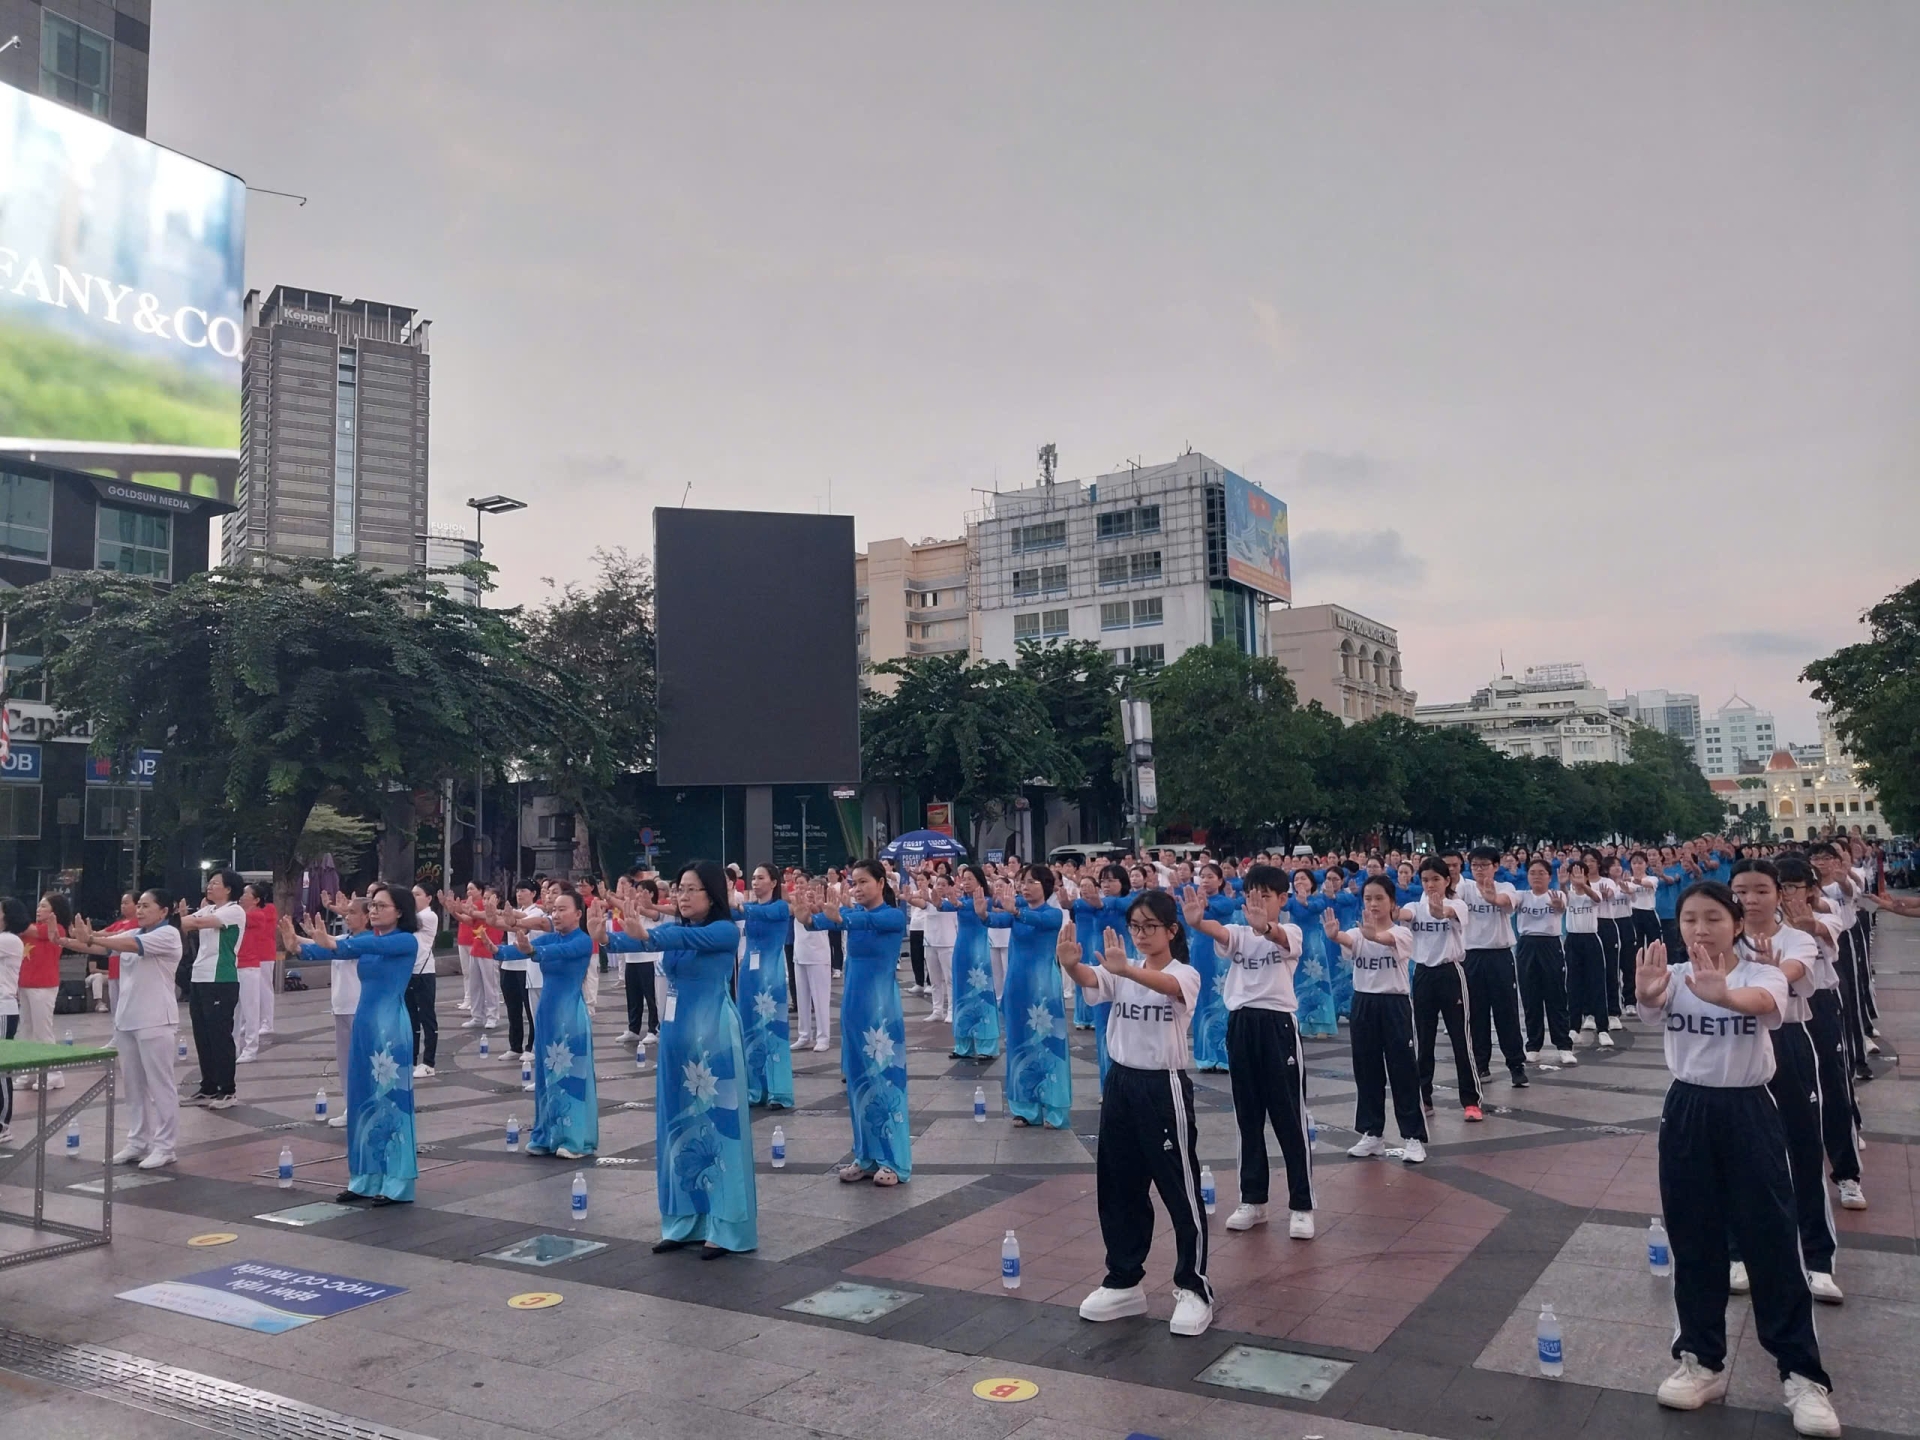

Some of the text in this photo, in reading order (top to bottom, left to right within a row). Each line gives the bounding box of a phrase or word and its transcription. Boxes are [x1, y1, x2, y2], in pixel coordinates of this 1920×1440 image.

[284, 308, 329, 325] Keppel
[108, 486, 190, 510] GOLDSUN MEDIA
[431, 521, 466, 532] FUSION
[1579, 726, 1608, 734] HOTEL
[1233, 951, 1282, 970] OLETTE
[1352, 956, 1398, 970] OLETTE
[1667, 1012, 1757, 1036] OLETTE
[989, 1384, 1020, 1398] B
